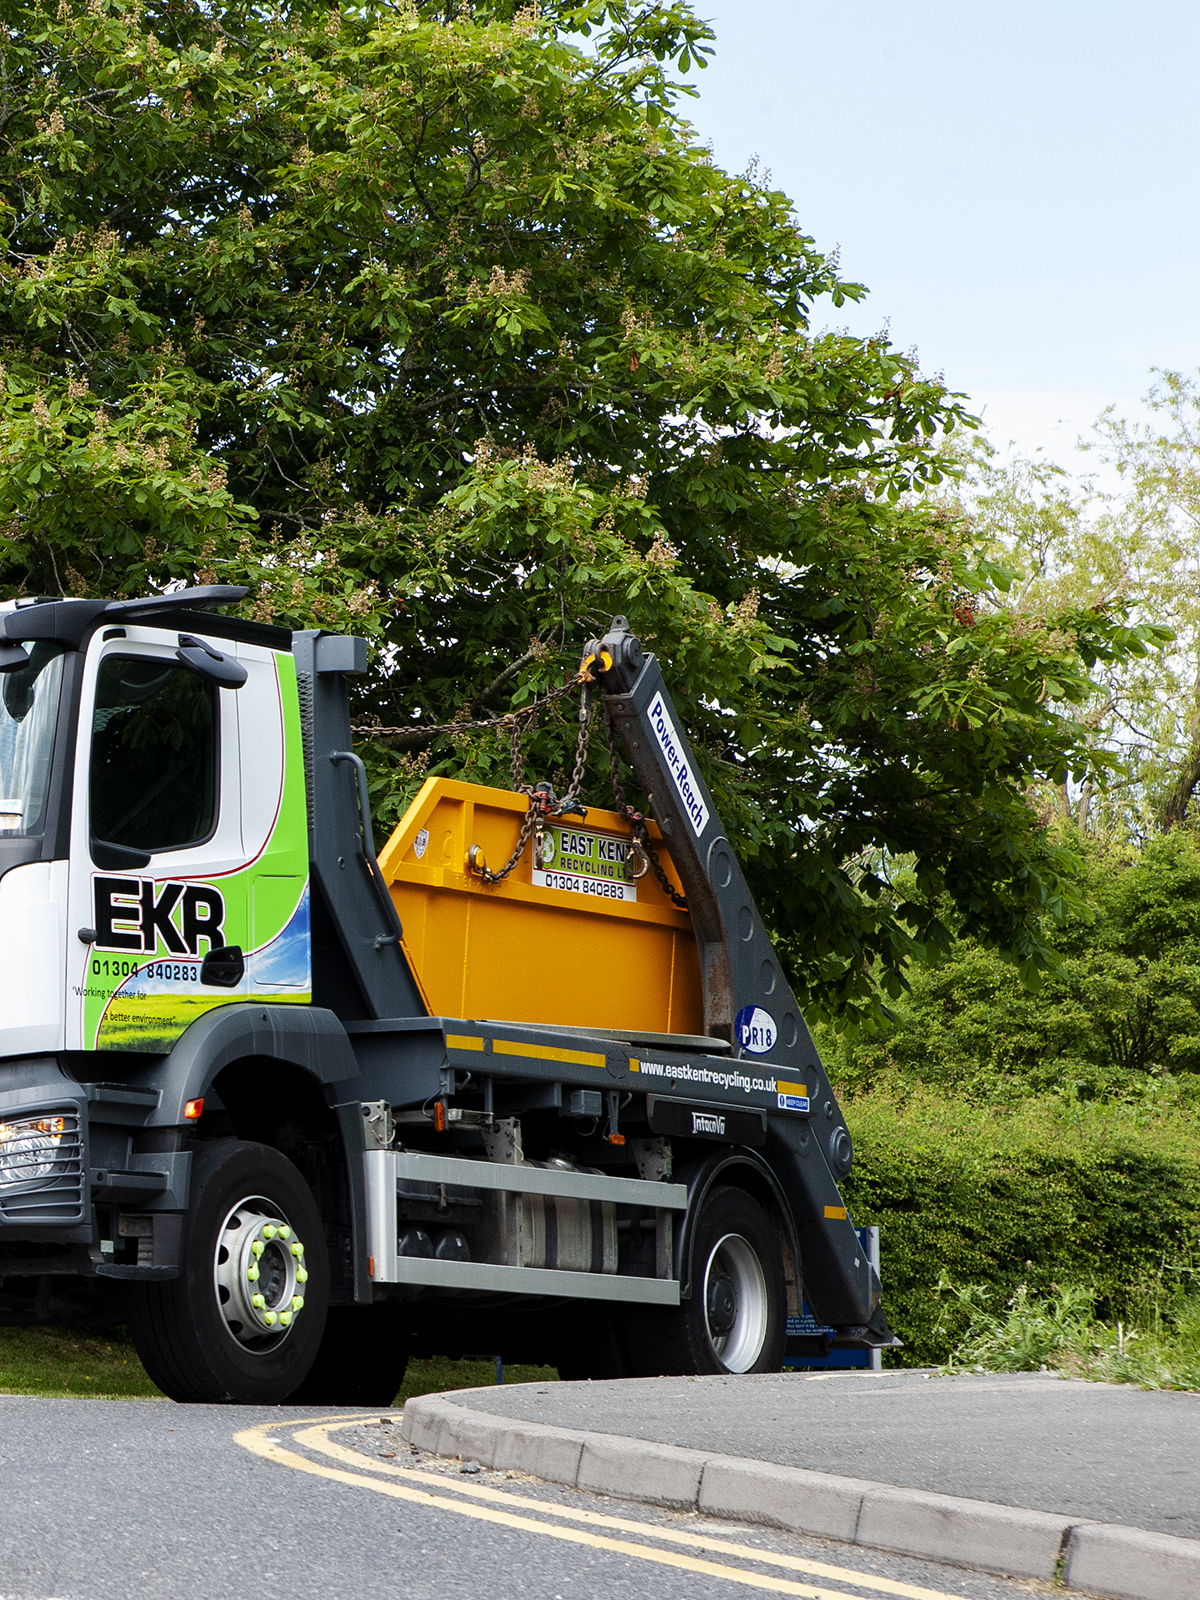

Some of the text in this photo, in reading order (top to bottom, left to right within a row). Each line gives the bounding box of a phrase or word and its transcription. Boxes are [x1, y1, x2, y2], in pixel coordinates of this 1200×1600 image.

[650, 700, 704, 829] Power-Reach
[560, 831, 595, 858] EAST
[560, 856, 614, 878] RECYCLING
[545, 873, 624, 900] 01304 840283
[92, 874, 226, 959] EKR
[92, 959, 198, 982] 01304 840283
[107, 989, 137, 1001] together
[137, 989, 147, 1001] for
[109, 1012, 131, 1022] better
[640, 1060, 778, 1093] www.eastkentrecycling.co.uk
